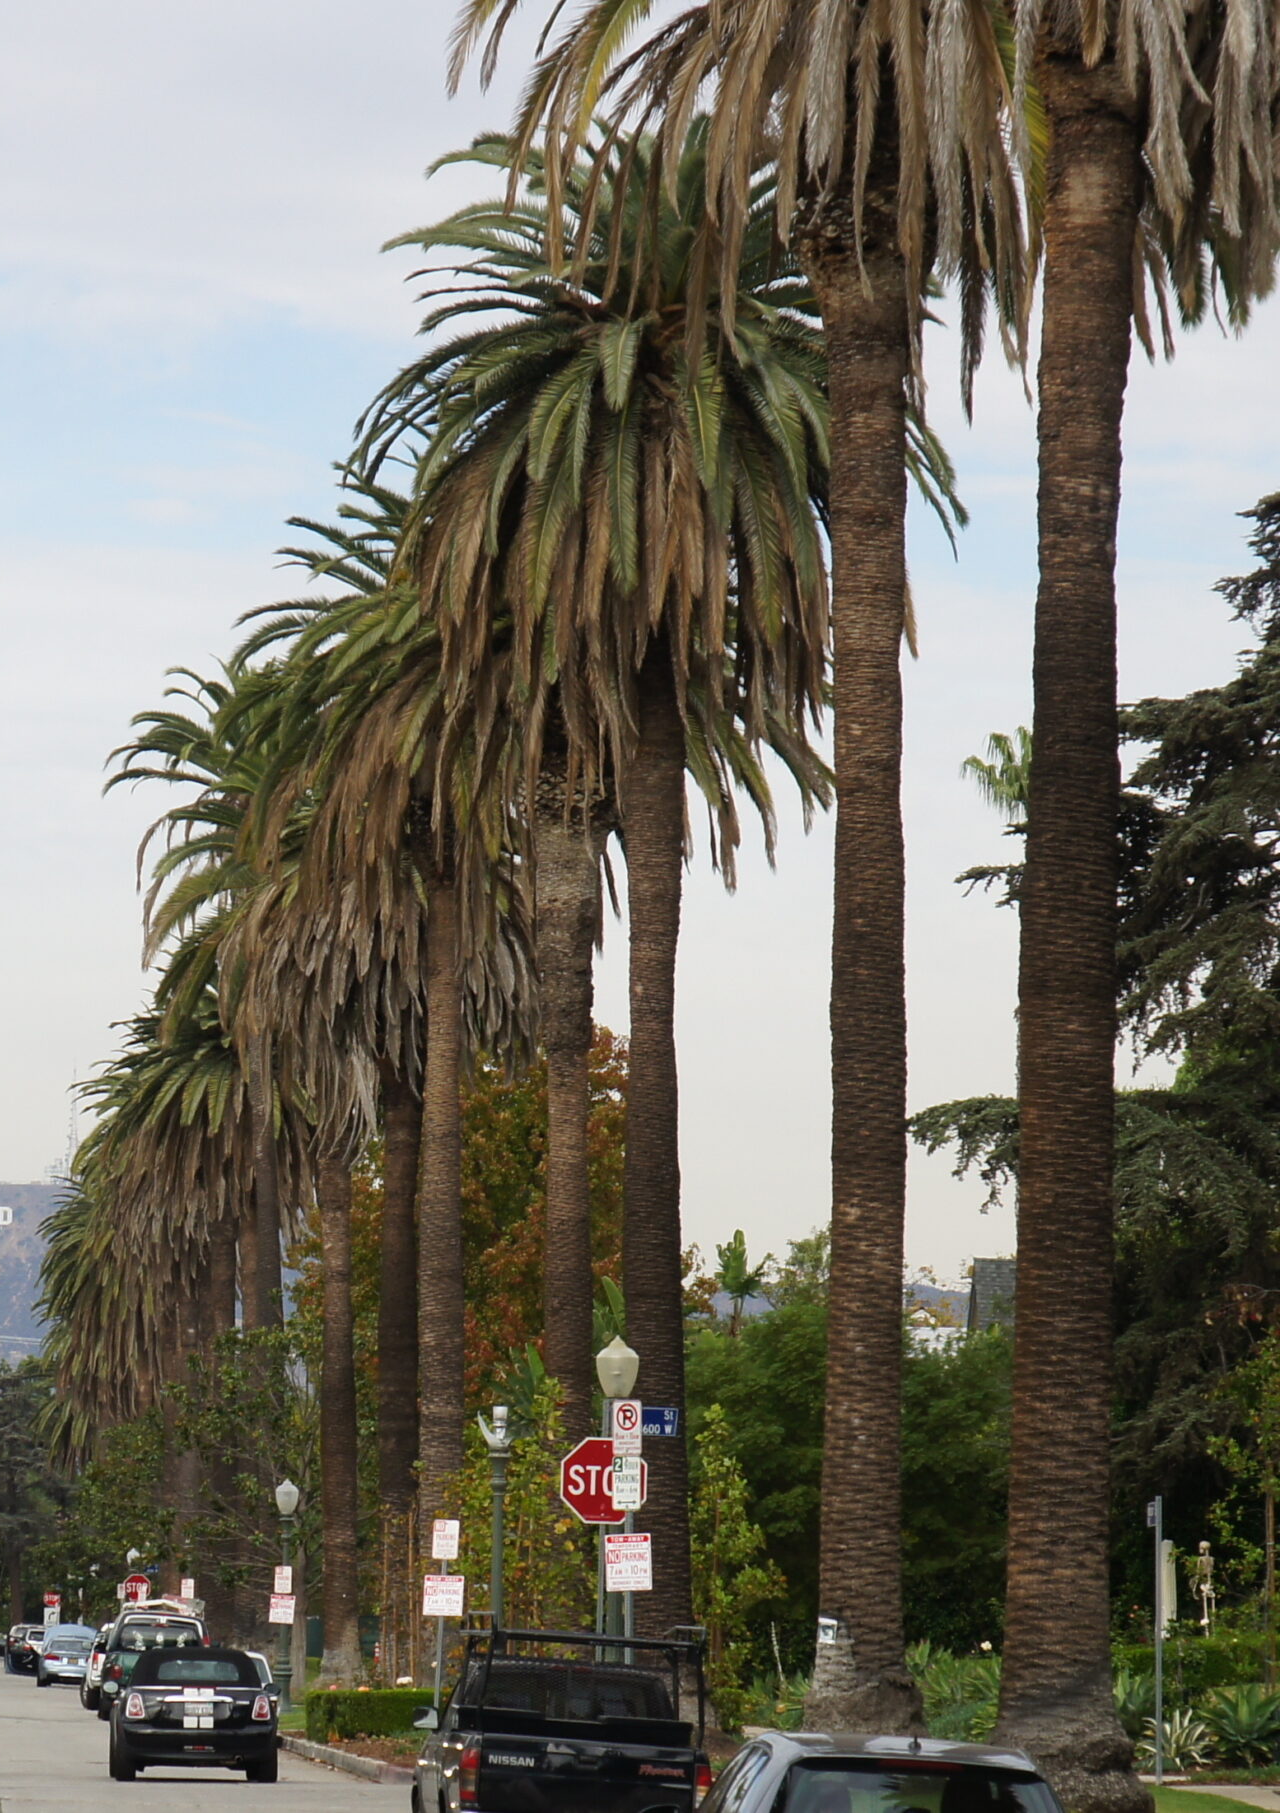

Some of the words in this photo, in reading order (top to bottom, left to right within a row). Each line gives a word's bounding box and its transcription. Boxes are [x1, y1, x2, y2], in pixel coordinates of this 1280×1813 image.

[664, 1409, 674, 1421] St
[642, 1423, 661, 1434] 600
[664, 1424, 673, 1435] W
[615, 1457, 622, 1472] 2
[567, 1464, 614, 1496] STO
[615, 1474, 639, 1484] PARKING
[608, 1550, 621, 1564] NO
[621, 1551, 648, 1562] PARKING
[126, 1582, 149, 1593] STOP
[438, 1588, 461, 1596] PARKING
[489, 1754, 535, 1767] NISSAN
